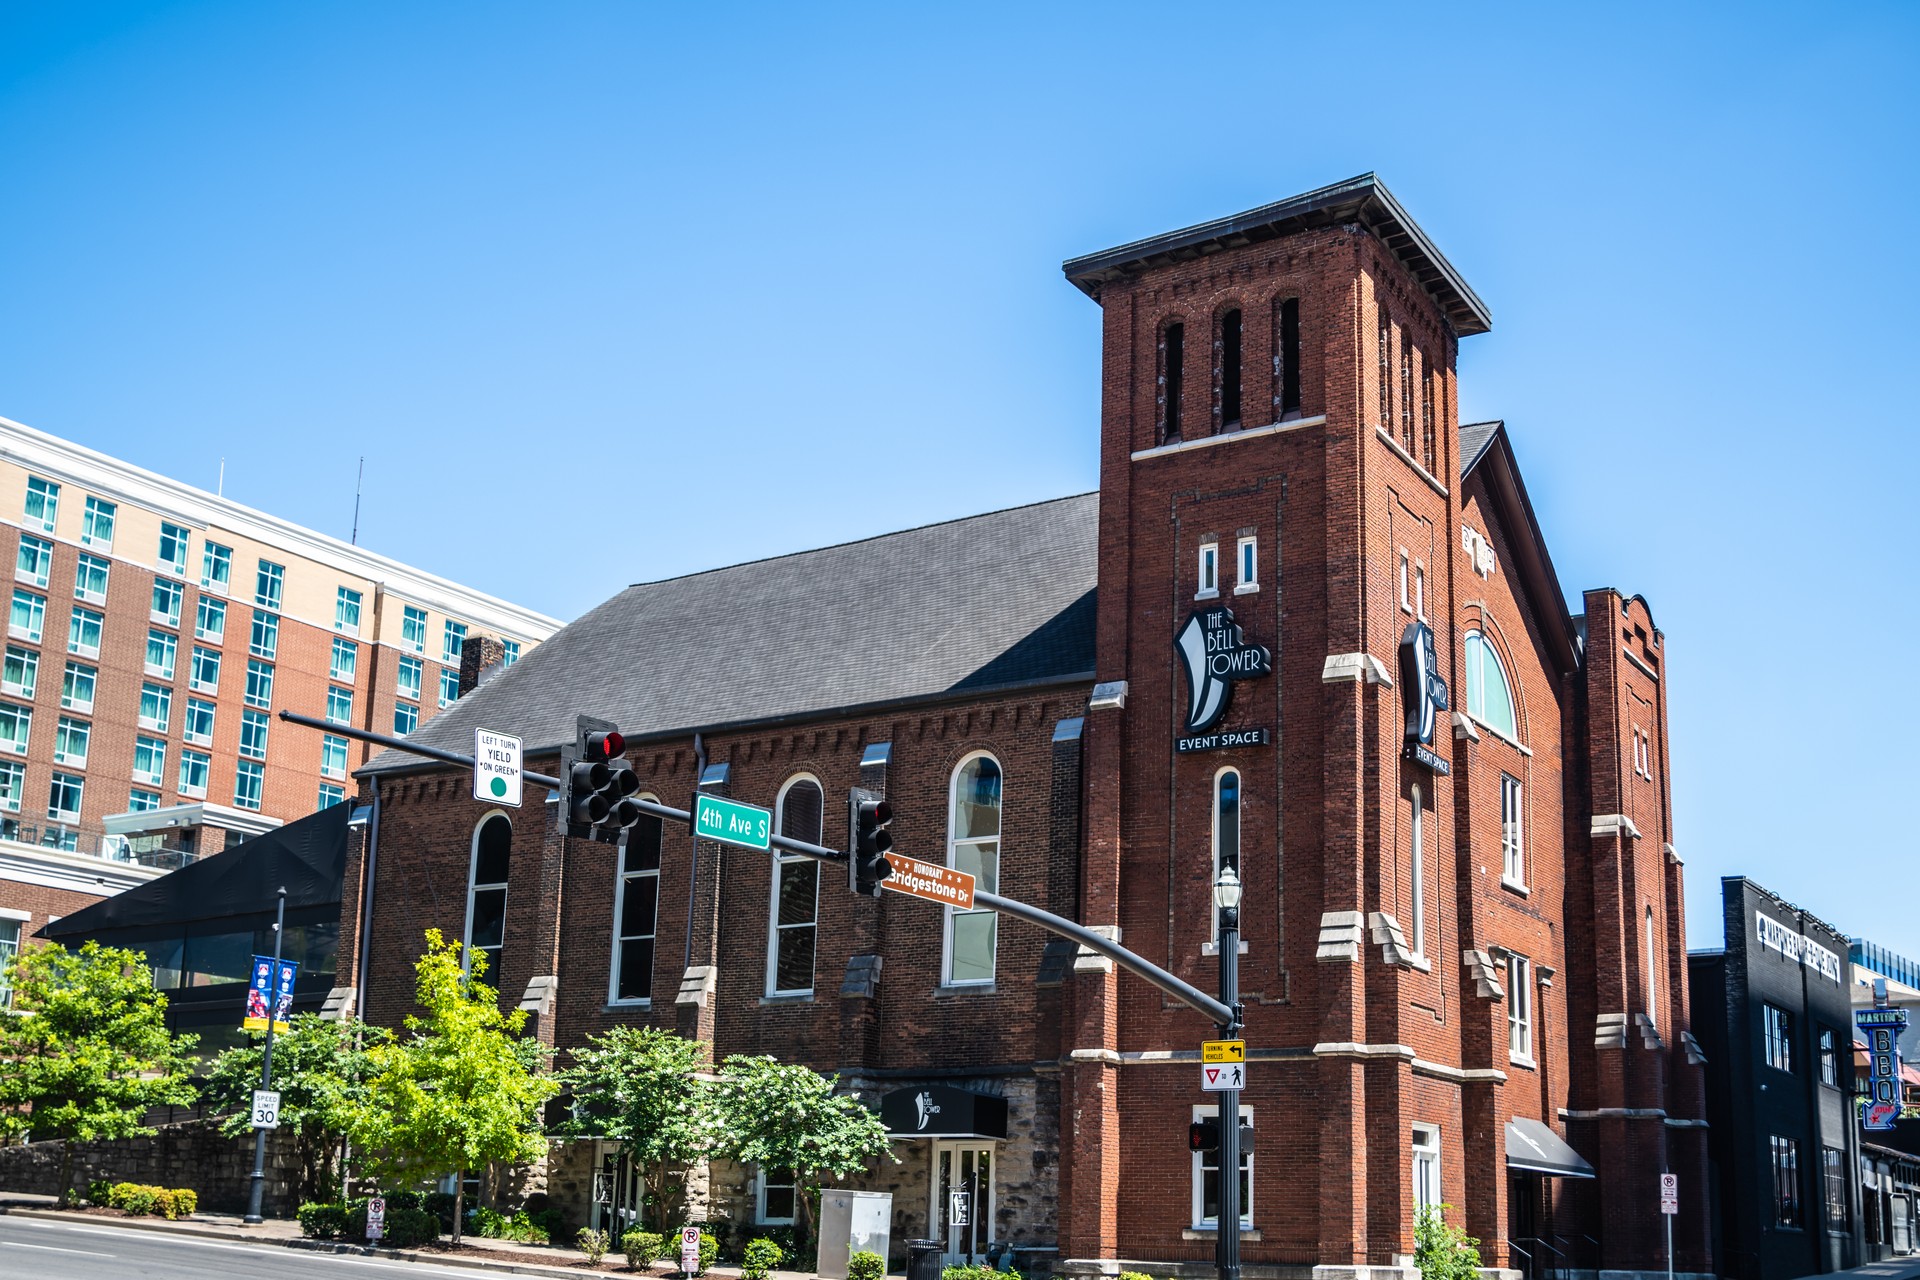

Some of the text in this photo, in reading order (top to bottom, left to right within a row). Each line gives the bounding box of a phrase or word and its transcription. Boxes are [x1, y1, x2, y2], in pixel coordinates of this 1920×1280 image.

[1207, 612, 1222, 629] THE
[1207, 629, 1234, 652] BELL
[1207, 649, 1260, 676] TOWER
[1425, 650, 1436, 676] BELL
[1426, 673, 1447, 706] TOWER
[482, 735, 516, 750] LEFT TURN
[1180, 731, 1259, 751] EVENT SPACE
[488, 748, 511, 763] YIELD
[1417, 747, 1448, 774] EVENT SPACE
[483, 762, 515, 776] ON GREEN
[701, 807, 766, 839] 4th Ave S
[913, 862, 944, 880] HONORARY
[888, 867, 969, 902] Bridgestone Dr
[1857, 1011, 1905, 1023] MARTIN'S
[1875, 1029, 1894, 1105] BBQ
[256, 1095, 277, 1103] SPEED
[257, 1102, 275, 1110] LIMIT
[256, 1110, 275, 1123] 30
